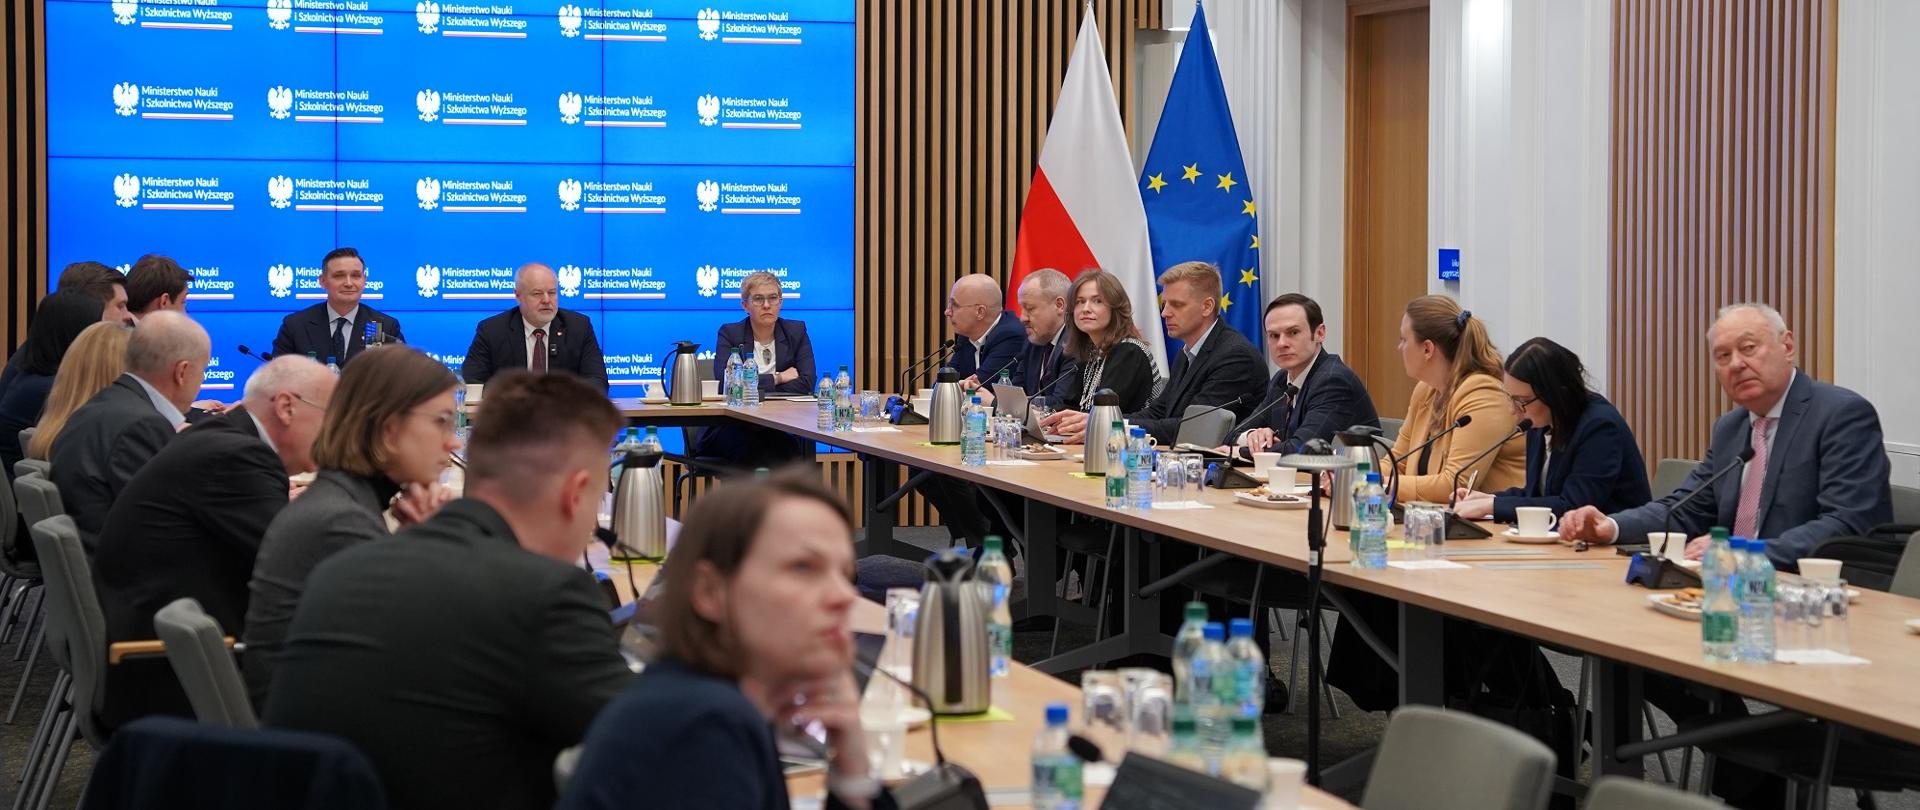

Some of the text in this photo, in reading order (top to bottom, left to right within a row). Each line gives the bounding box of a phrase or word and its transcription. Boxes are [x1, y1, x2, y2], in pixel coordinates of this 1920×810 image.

[295, 0, 368, 10] Ministerstwo Nauki
[442, 4, 512, 14] Ministerstwo Nauki
[145, 7, 191, 17] Szkolnictwa
[193, 9, 232, 21] Wyższego
[584, 8, 652, 18] Ministerstwo Nauki
[722, 11, 788, 21] Ministerstwo Nauki
[299, 12, 344, 22] Szkolnictwa
[345, 14, 383, 25] Wyższego
[447, 17, 489, 26] Szkolnictwa
[490, 18, 527, 29] Wyższego
[588, 20, 630, 30] Szkolnictwa
[631, 21, 666, 32] Wyższego
[726, 23, 766, 33] Szkolnictwa
[767, 25, 801, 35] Wyższego
[142, 86, 217, 96] Ministerstwo Nauki
[295, 89, 368, 100] Ministerstwo Nauki
[443, 93, 512, 102] Ministerstwo Nauki
[584, 96, 652, 105] Ministerstwo Nauki
[722, 98, 788, 107] Ministerstwo Nauki
[146, 98, 192, 108] Szkolnictwa
[194, 100, 233, 111] Wyższego
[299, 101, 344, 111] Szkolnictwa
[346, 103, 383, 114] Wyższego
[447, 104, 489, 114] Szkolnictwa
[491, 105, 527, 116] Wyższego
[588, 107, 630, 116] Szkolnictwa
[631, 108, 666, 118] Wyższego
[726, 109, 766, 118] Szkolnictwa
[767, 110, 801, 120] Wyższego
[143, 177, 218, 187] Ministerstwo Nauki
[296, 179, 368, 188] Ministerstwo Nauki
[443, 181, 512, 190] Ministerstwo Nauki
[584, 182, 652, 191] Ministerstwo Nauki
[722, 183, 787, 192] Ministerstwo Nauki
[147, 189, 193, 198] Szkolnictwa
[194, 190, 234, 201] Wyższego
[300, 191, 344, 200] Szkolnictwa
[346, 192, 383, 202] Wyższego
[447, 192, 489, 201] Szkolnictwa
[490, 193, 526, 203] Wyższego
[588, 194, 629, 202] Szkolnictwa
[631, 194, 666, 204] Wyższego
[725, 194, 765, 203] Szkolnictwa
[767, 195, 800, 205] Wyższego
[196, 268, 218, 276] Nauki
[442, 268, 512, 277] Ministerstwo Nauki
[584, 268, 651, 277] Ministerstwo Nauki
[195, 280, 234, 290] Wyższego
[447, 279, 489, 288] Szkolnictwa
[490, 279, 515, 290] Wyższ
[588, 279, 629, 288] Szkolnictwa
[630, 280, 665, 290] Wyższego
[631, 354, 652, 363] Nauki
[203, 369, 234, 380] yższego
